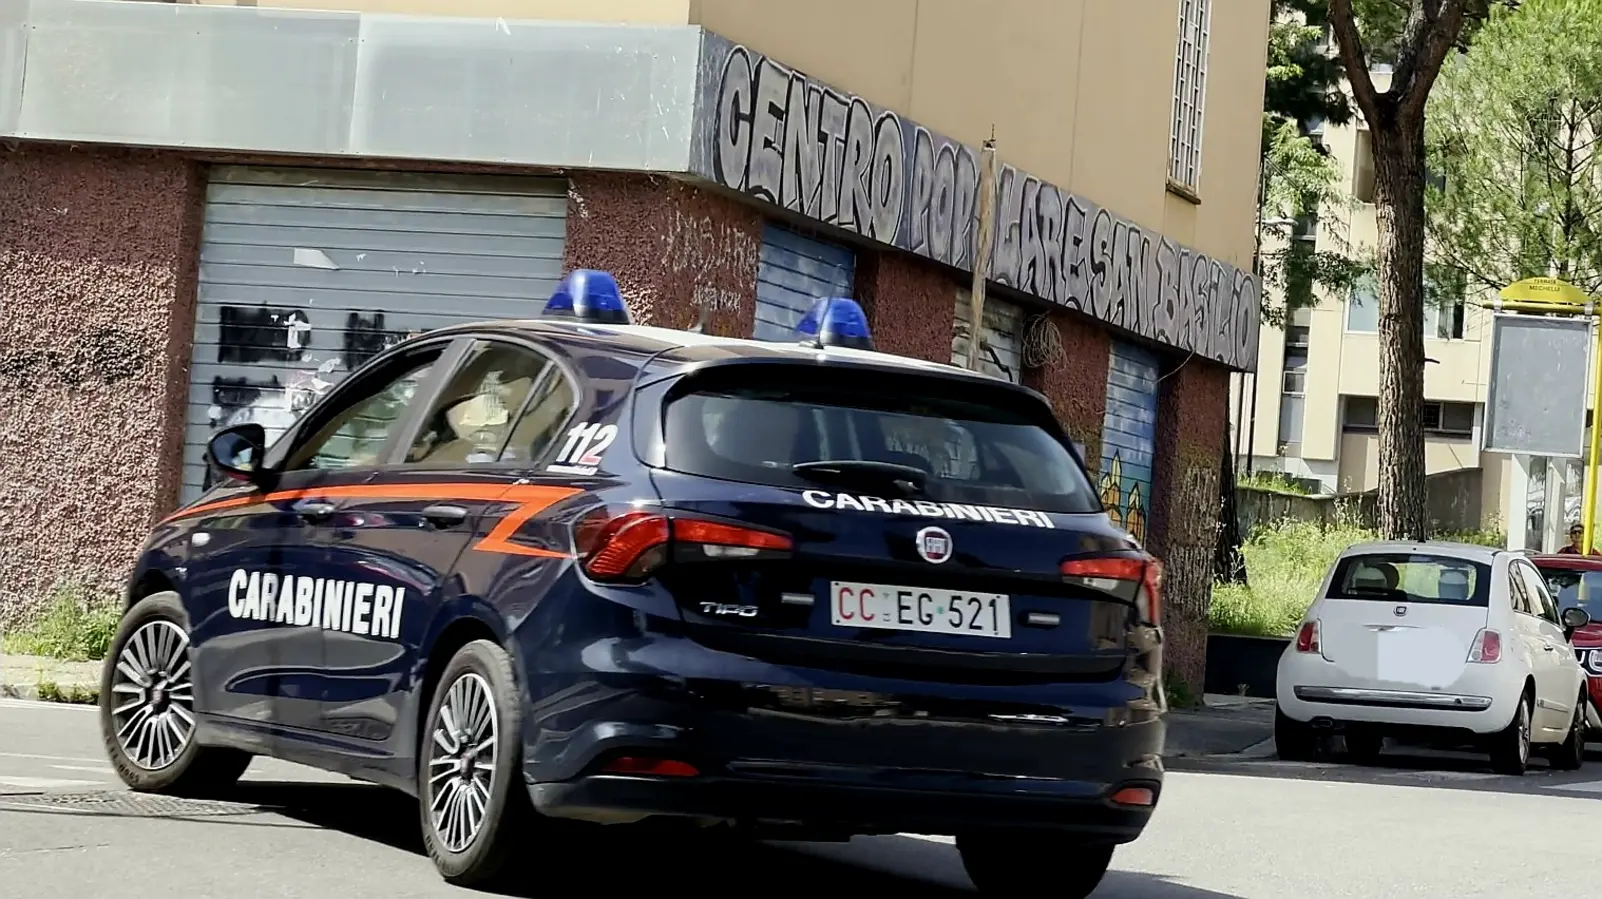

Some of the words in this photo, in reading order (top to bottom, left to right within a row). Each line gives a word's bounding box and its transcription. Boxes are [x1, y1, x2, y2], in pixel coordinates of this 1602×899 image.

[712, 44, 906, 247] CENTRO
[1089, 208, 1151, 339] SAN
[1153, 235, 1257, 370] BASILIO
[556, 421, 619, 466] 112
[801, 488, 1055, 529] CARABINIERI
[227, 568, 406, 639] CARABINIERI
[699, 601, 759, 617] TIPO
[838, 586, 876, 622] CC
[896, 590, 934, 626] EG
[948, 595, 999, 632] 521
